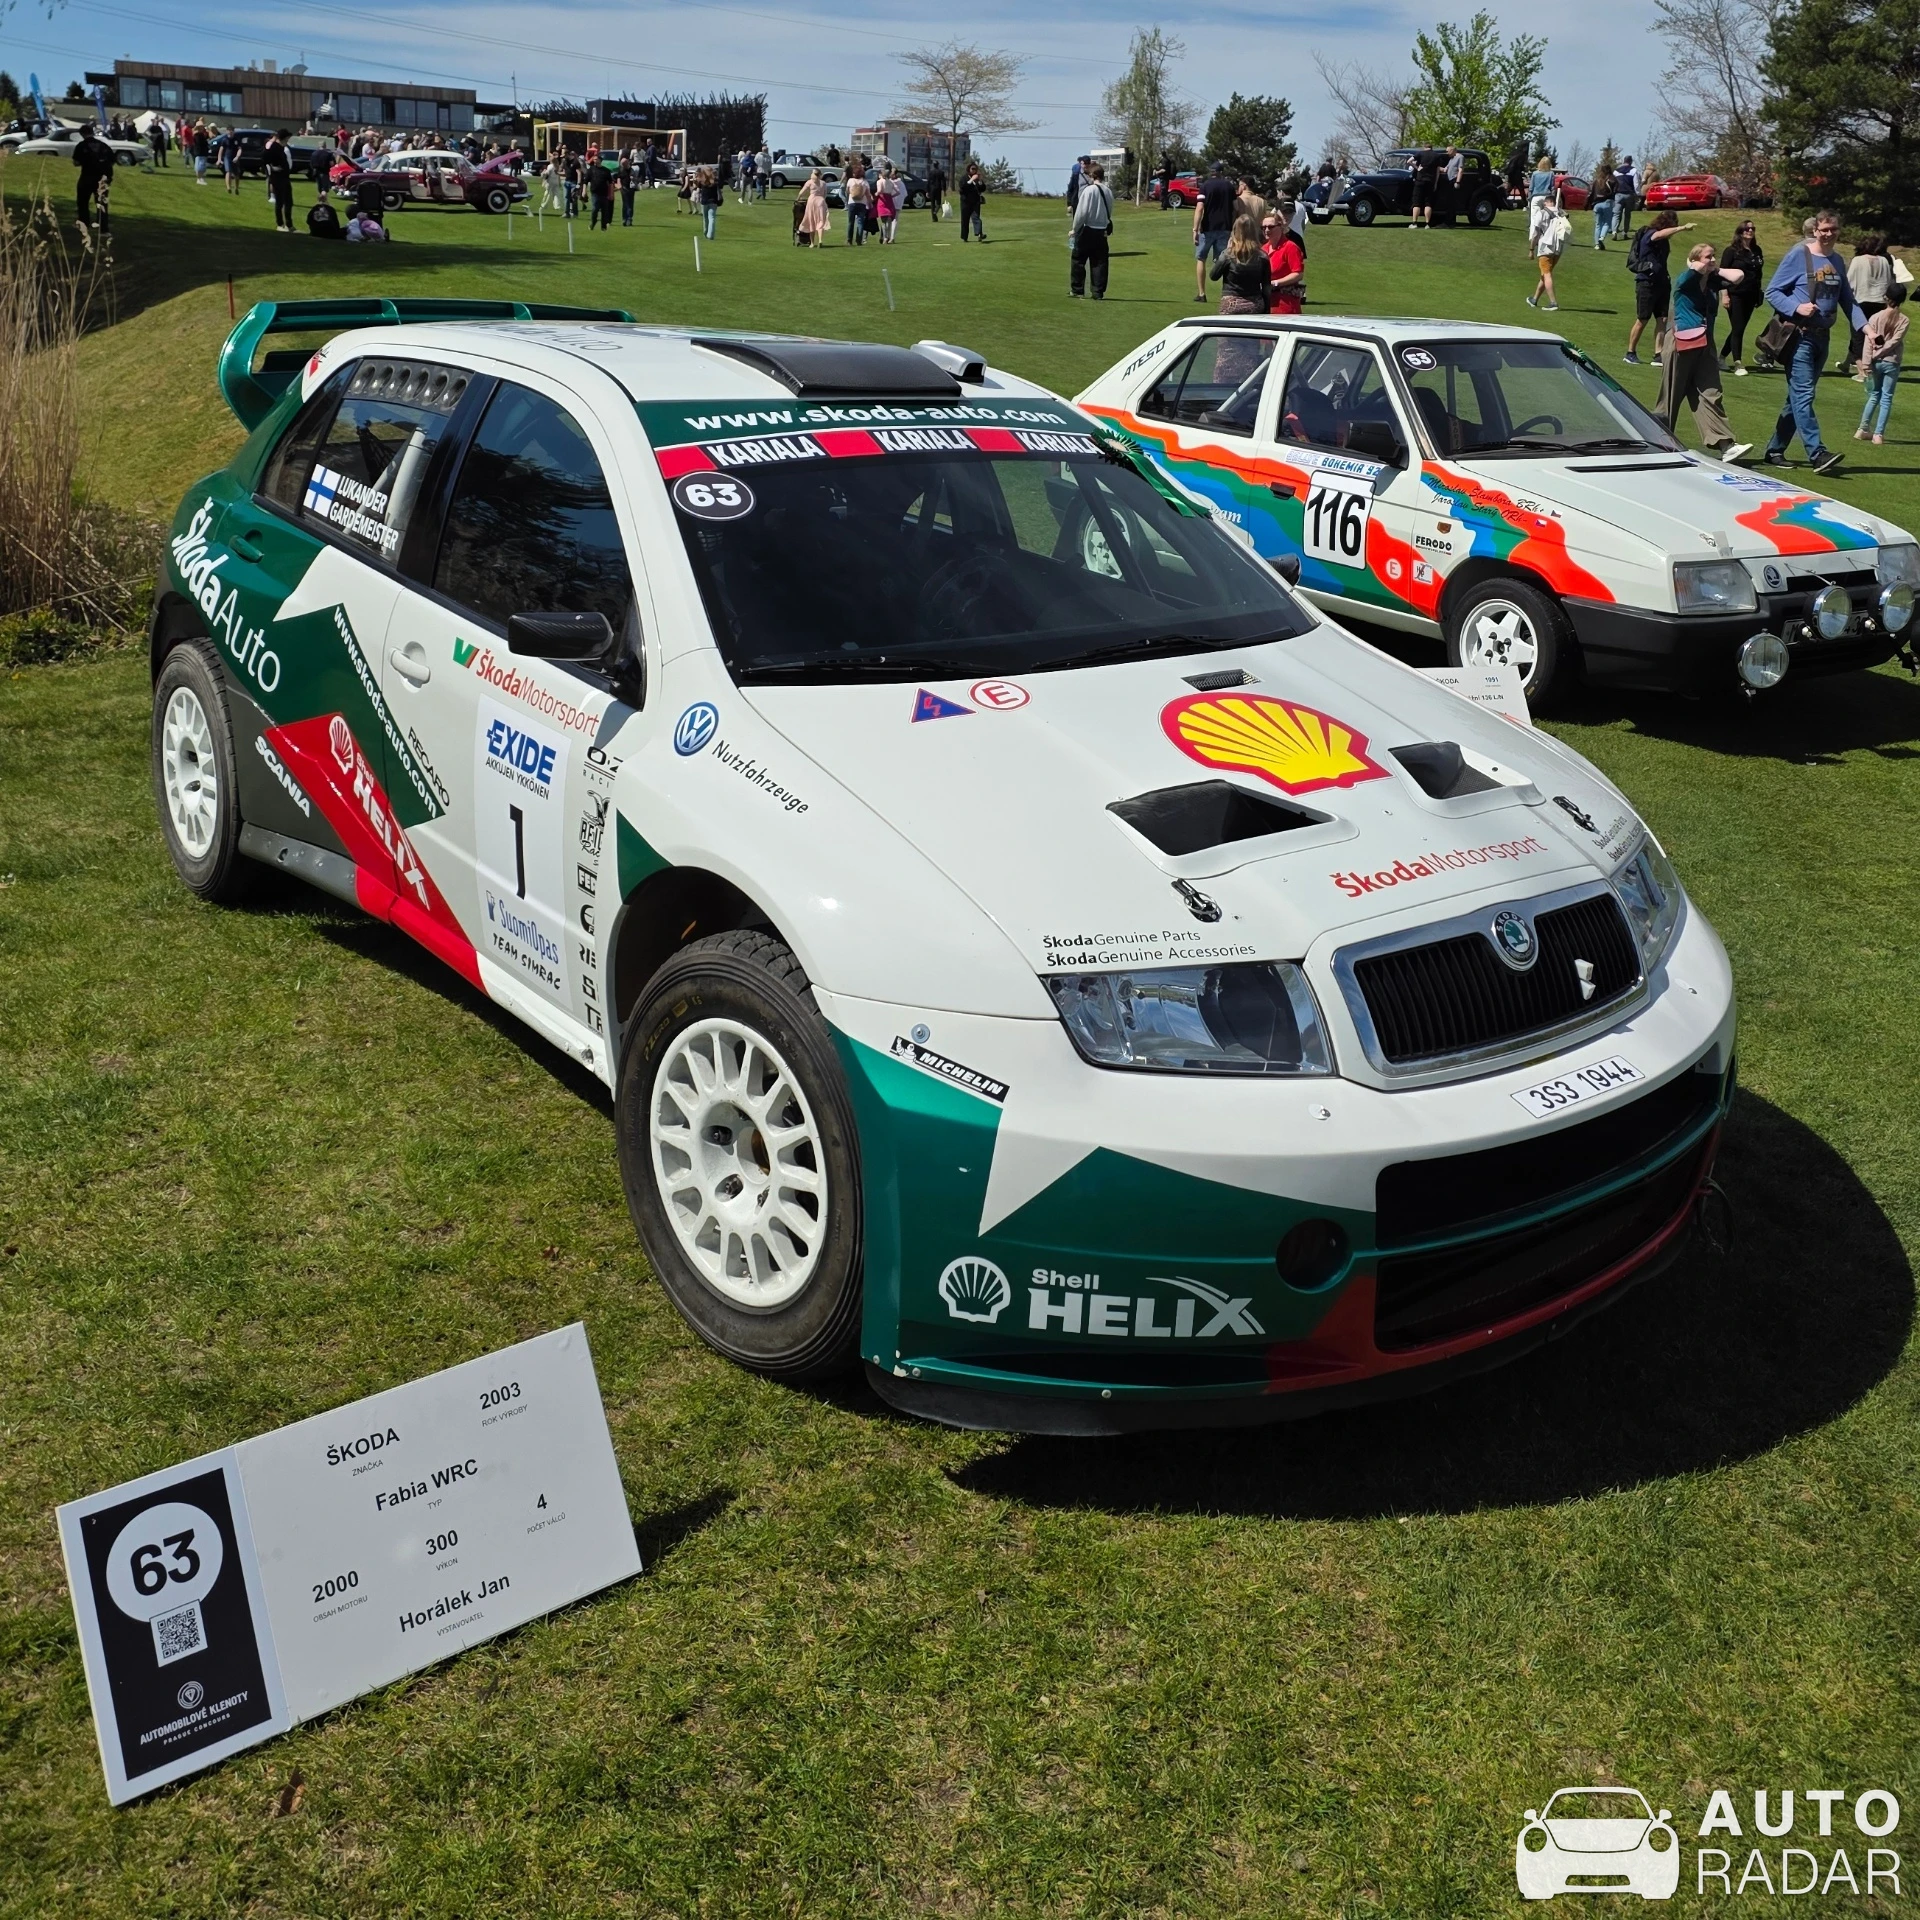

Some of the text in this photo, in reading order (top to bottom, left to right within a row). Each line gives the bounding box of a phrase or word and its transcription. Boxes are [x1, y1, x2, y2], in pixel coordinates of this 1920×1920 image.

[1406, 353, 1431, 366] 53
[684, 406, 1067, 430] www.skoda-auto.com
[706, 429, 1104, 467] KARIALA KARIALA KARIALA
[1322, 457, 1365, 473] BOHEMIA
[337, 475, 388, 515] LUKANDER
[686, 483, 742, 507] 63
[1427, 477, 1466, 495] Miroslav
[1431, 492, 1468, 509] Jaroslav
[329, 502, 399, 551] GARDEMEISTER
[1307, 488, 1366, 557] 116
[1416, 535, 1452, 551] FERODO
[171, 496, 281, 693] ŠkodaAuto
[476, 648, 599, 737] ŠkodaMotorsport
[333, 606, 437, 819] www.skoda-auto.com
[407, 726, 450, 807] RECARO
[487, 719, 557, 785] EXIDE
[255, 735, 310, 819] SCANIA
[485, 755, 550, 800] AKKUJEN YKKÖNEN
[712, 740, 809, 814] Nutzfahrzeuge
[509, 804, 526, 900] 1
[1329, 836, 1549, 897] ŠkodaMotorsport
[499, 898, 559, 965] SuomiOpas
[1043, 930, 1201, 949] ŠkodaGenuine Parts
[493, 933, 561, 990] TEAM SIMRAC
[1046, 943, 1257, 967] ŠkodaGenuine Accessories
[919, 1052, 1004, 1095] MICHELIN
[1529, 1060, 1636, 1109] 3S3 1944
[1031, 1268, 1100, 1290] Shell
[1027, 1278, 1266, 1338] HELIX
[480, 1382, 521, 1410] 2003
[481, 1404, 528, 1428] ROK VÝROBY
[326, 1427, 400, 1466] ŠKODA
[352, 1459, 384, 1477] ZNAČKA
[375, 1459, 479, 1511] Fabia WRC
[427, 1498, 442, 1511] TYP
[536, 1493, 548, 1510] 4
[526, 1512, 566, 1535] POČET VÁLCŮ
[130, 1528, 200, 1596] 63
[425, 1530, 459, 1556] 300
[436, 1557, 458, 1571] VÝKON
[312, 1570, 360, 1603] 2000
[399, 1576, 511, 1633] Horálek Jan
[313, 1595, 368, 1623] OBSAH MOTORU
[436, 1612, 485, 1637] VYSTAVOVATEL
[139, 1691, 249, 1746] AUTOMOBILOVÉ KLENOTY
[163, 1713, 231, 1746] PRAGUE CONCOURS
